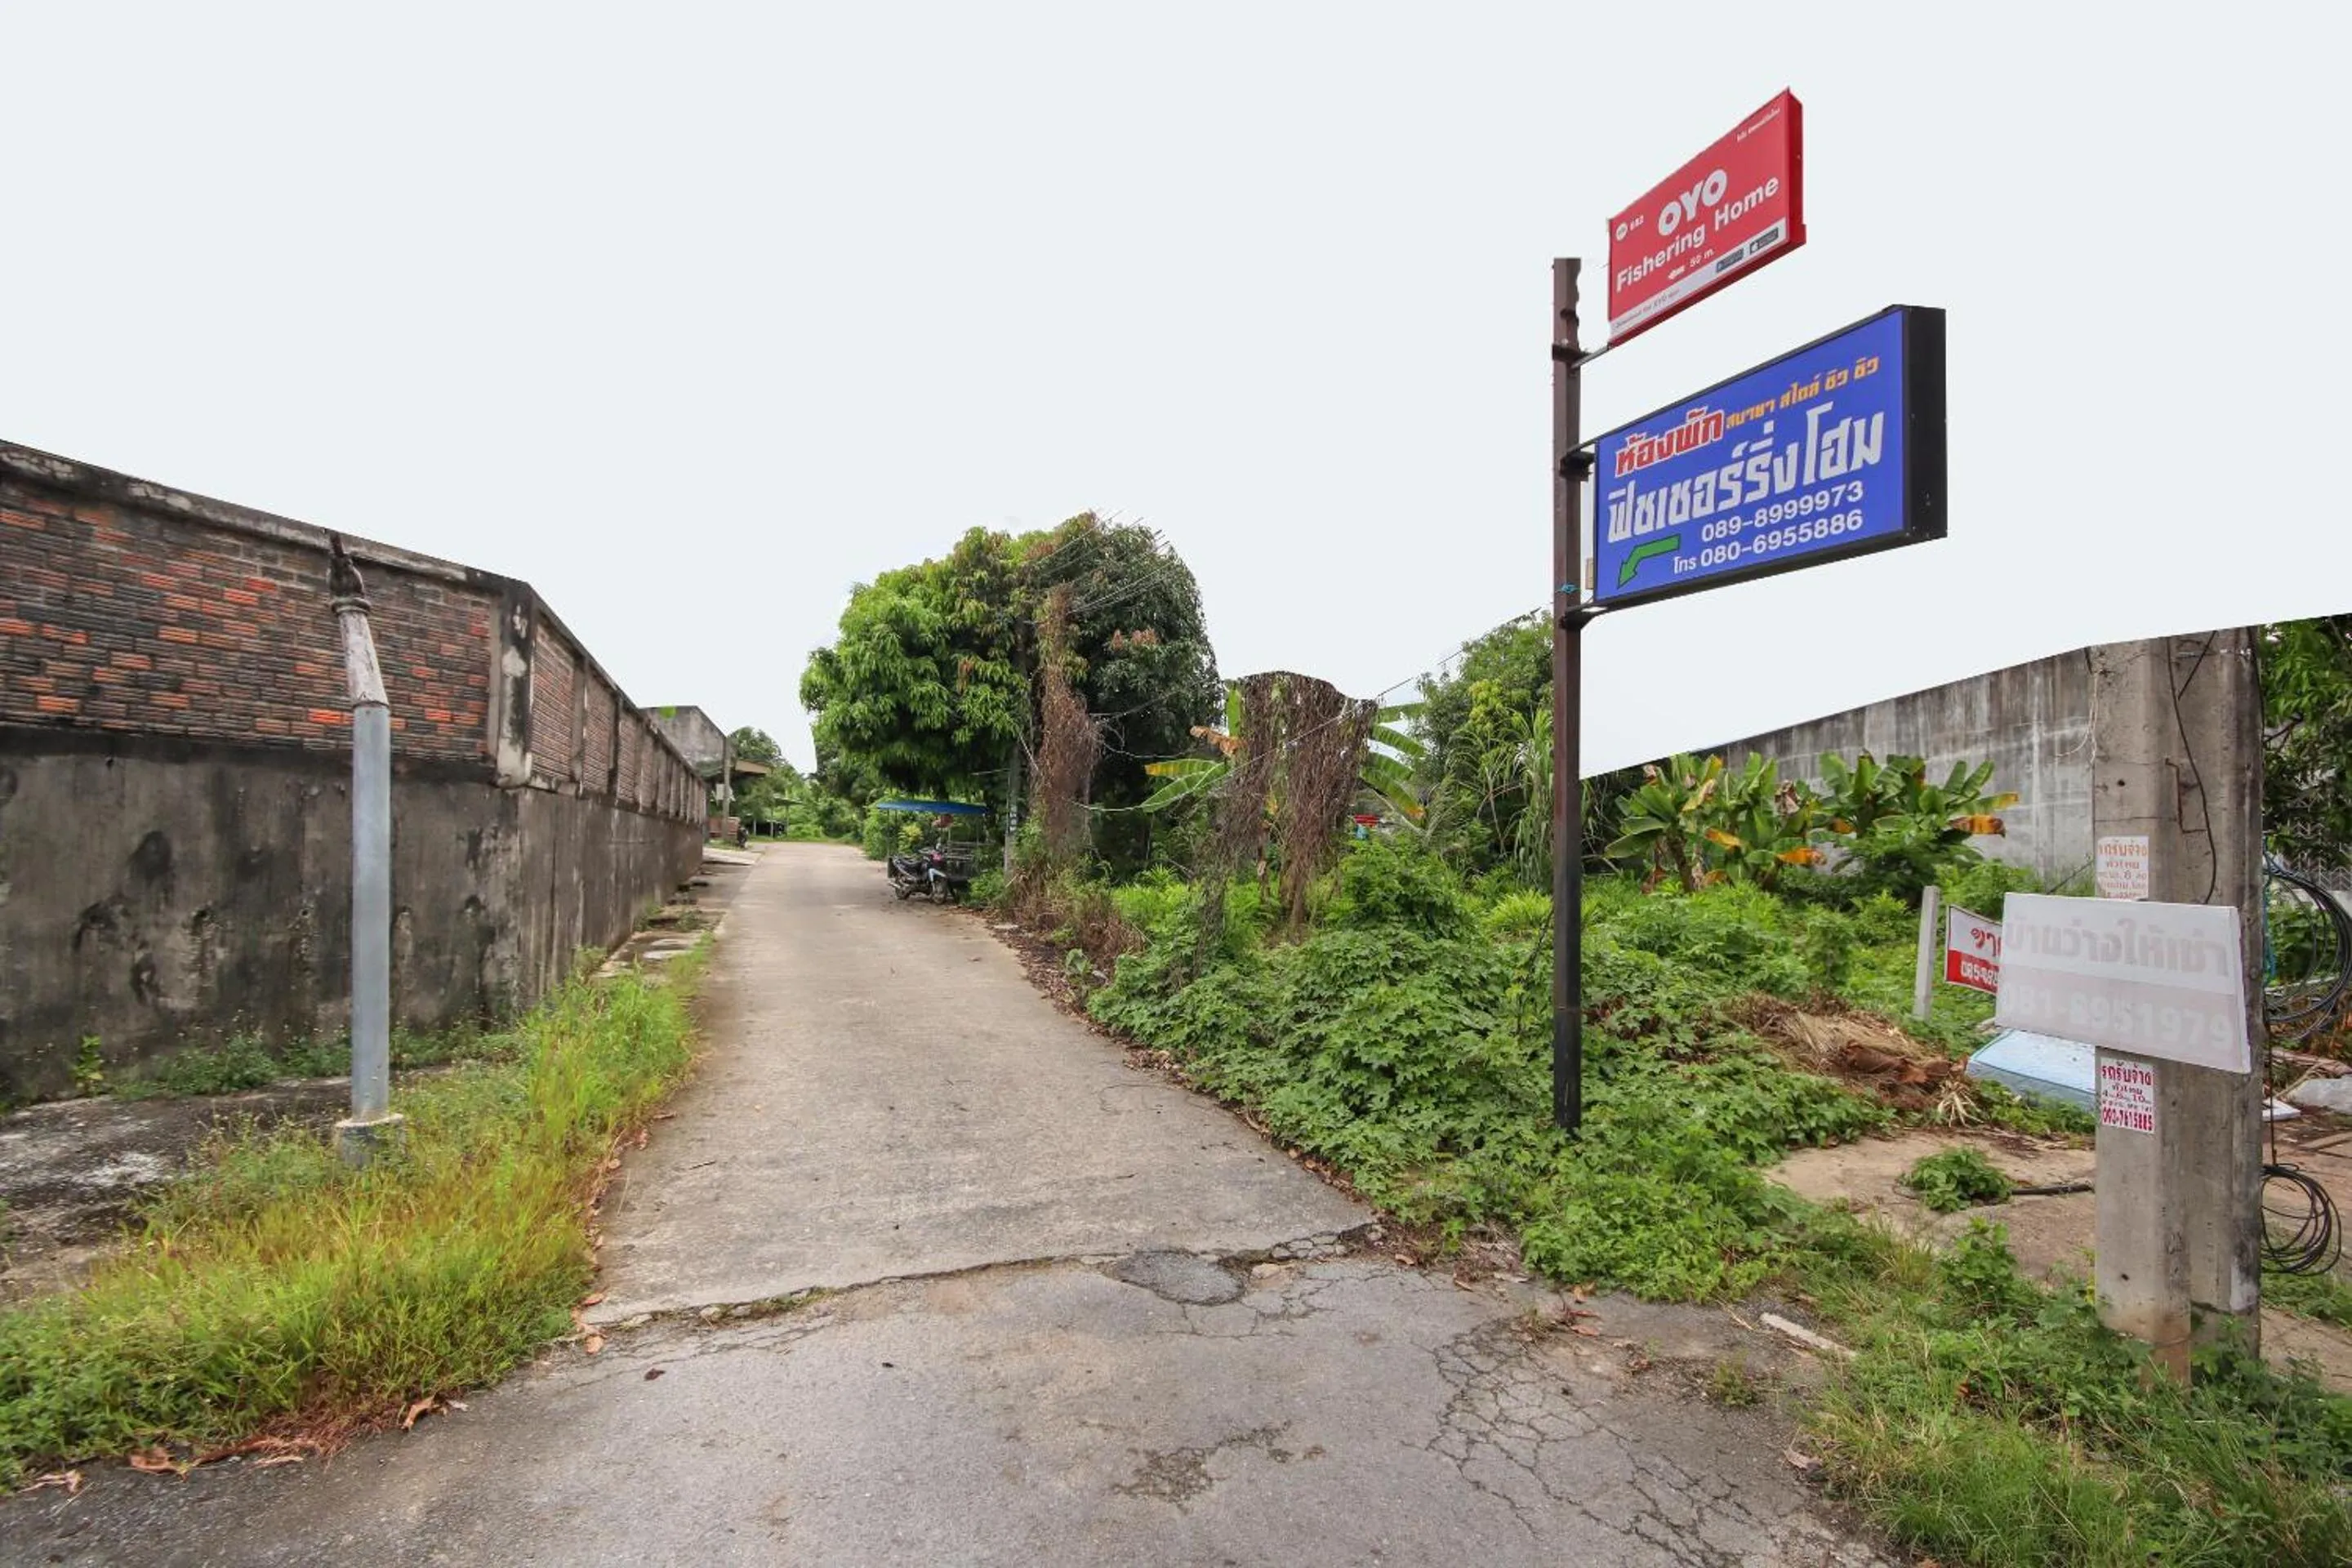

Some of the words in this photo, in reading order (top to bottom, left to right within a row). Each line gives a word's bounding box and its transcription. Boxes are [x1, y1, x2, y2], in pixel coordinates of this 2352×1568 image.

[1616, 223, 1706, 293] Fishering
[1714, 176, 1779, 231] Home
[1658, 168, 1727, 236] OYO
[1615, 406, 1724, 478] ห้องพัก
[1700, 509, 1863, 567] 080-6955886
[1701, 480, 1864, 542] 089-8999973
[1971, 928, 2001, 957] ขา
